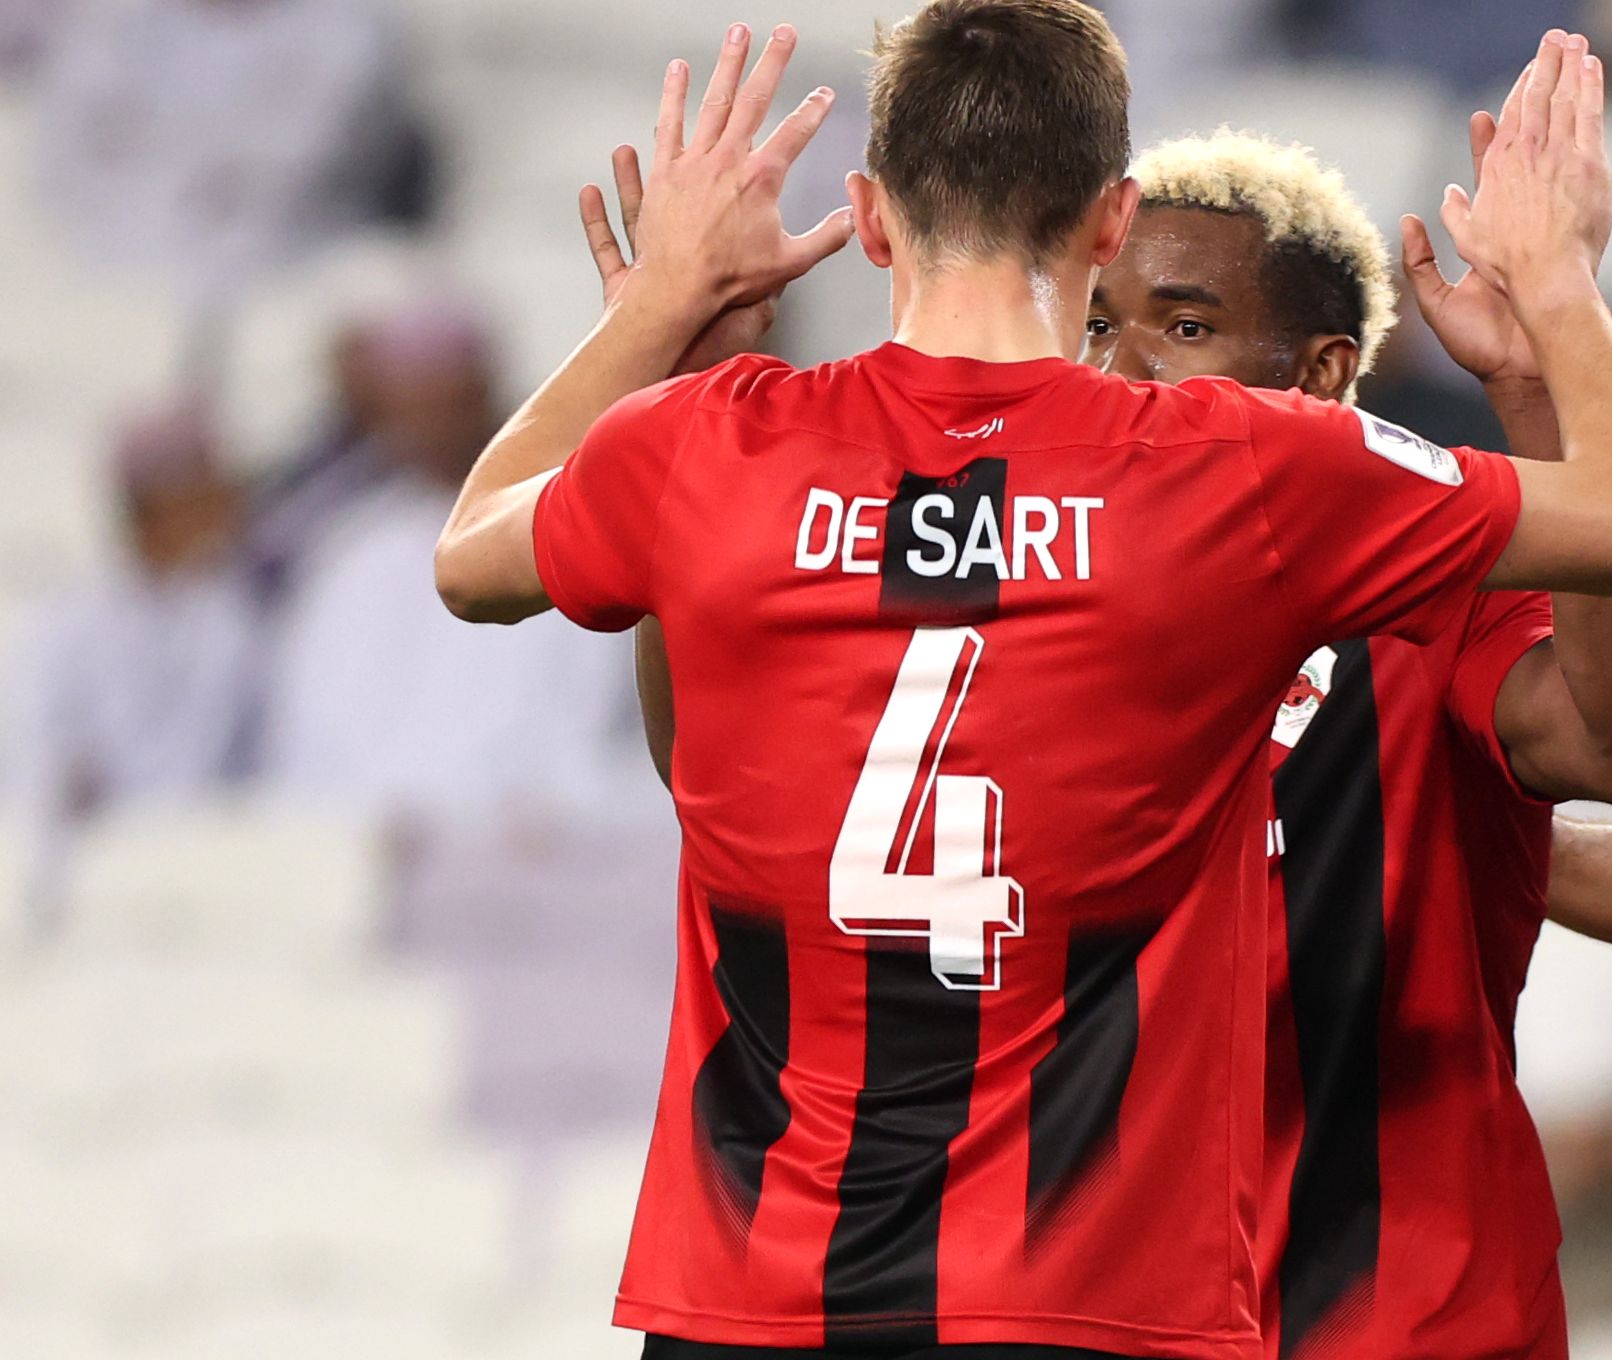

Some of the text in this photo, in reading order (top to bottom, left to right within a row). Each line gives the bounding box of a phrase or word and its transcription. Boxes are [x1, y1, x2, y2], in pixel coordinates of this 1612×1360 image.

[794, 488, 1104, 581] DE SART
[829, 625, 1025, 991] 4
